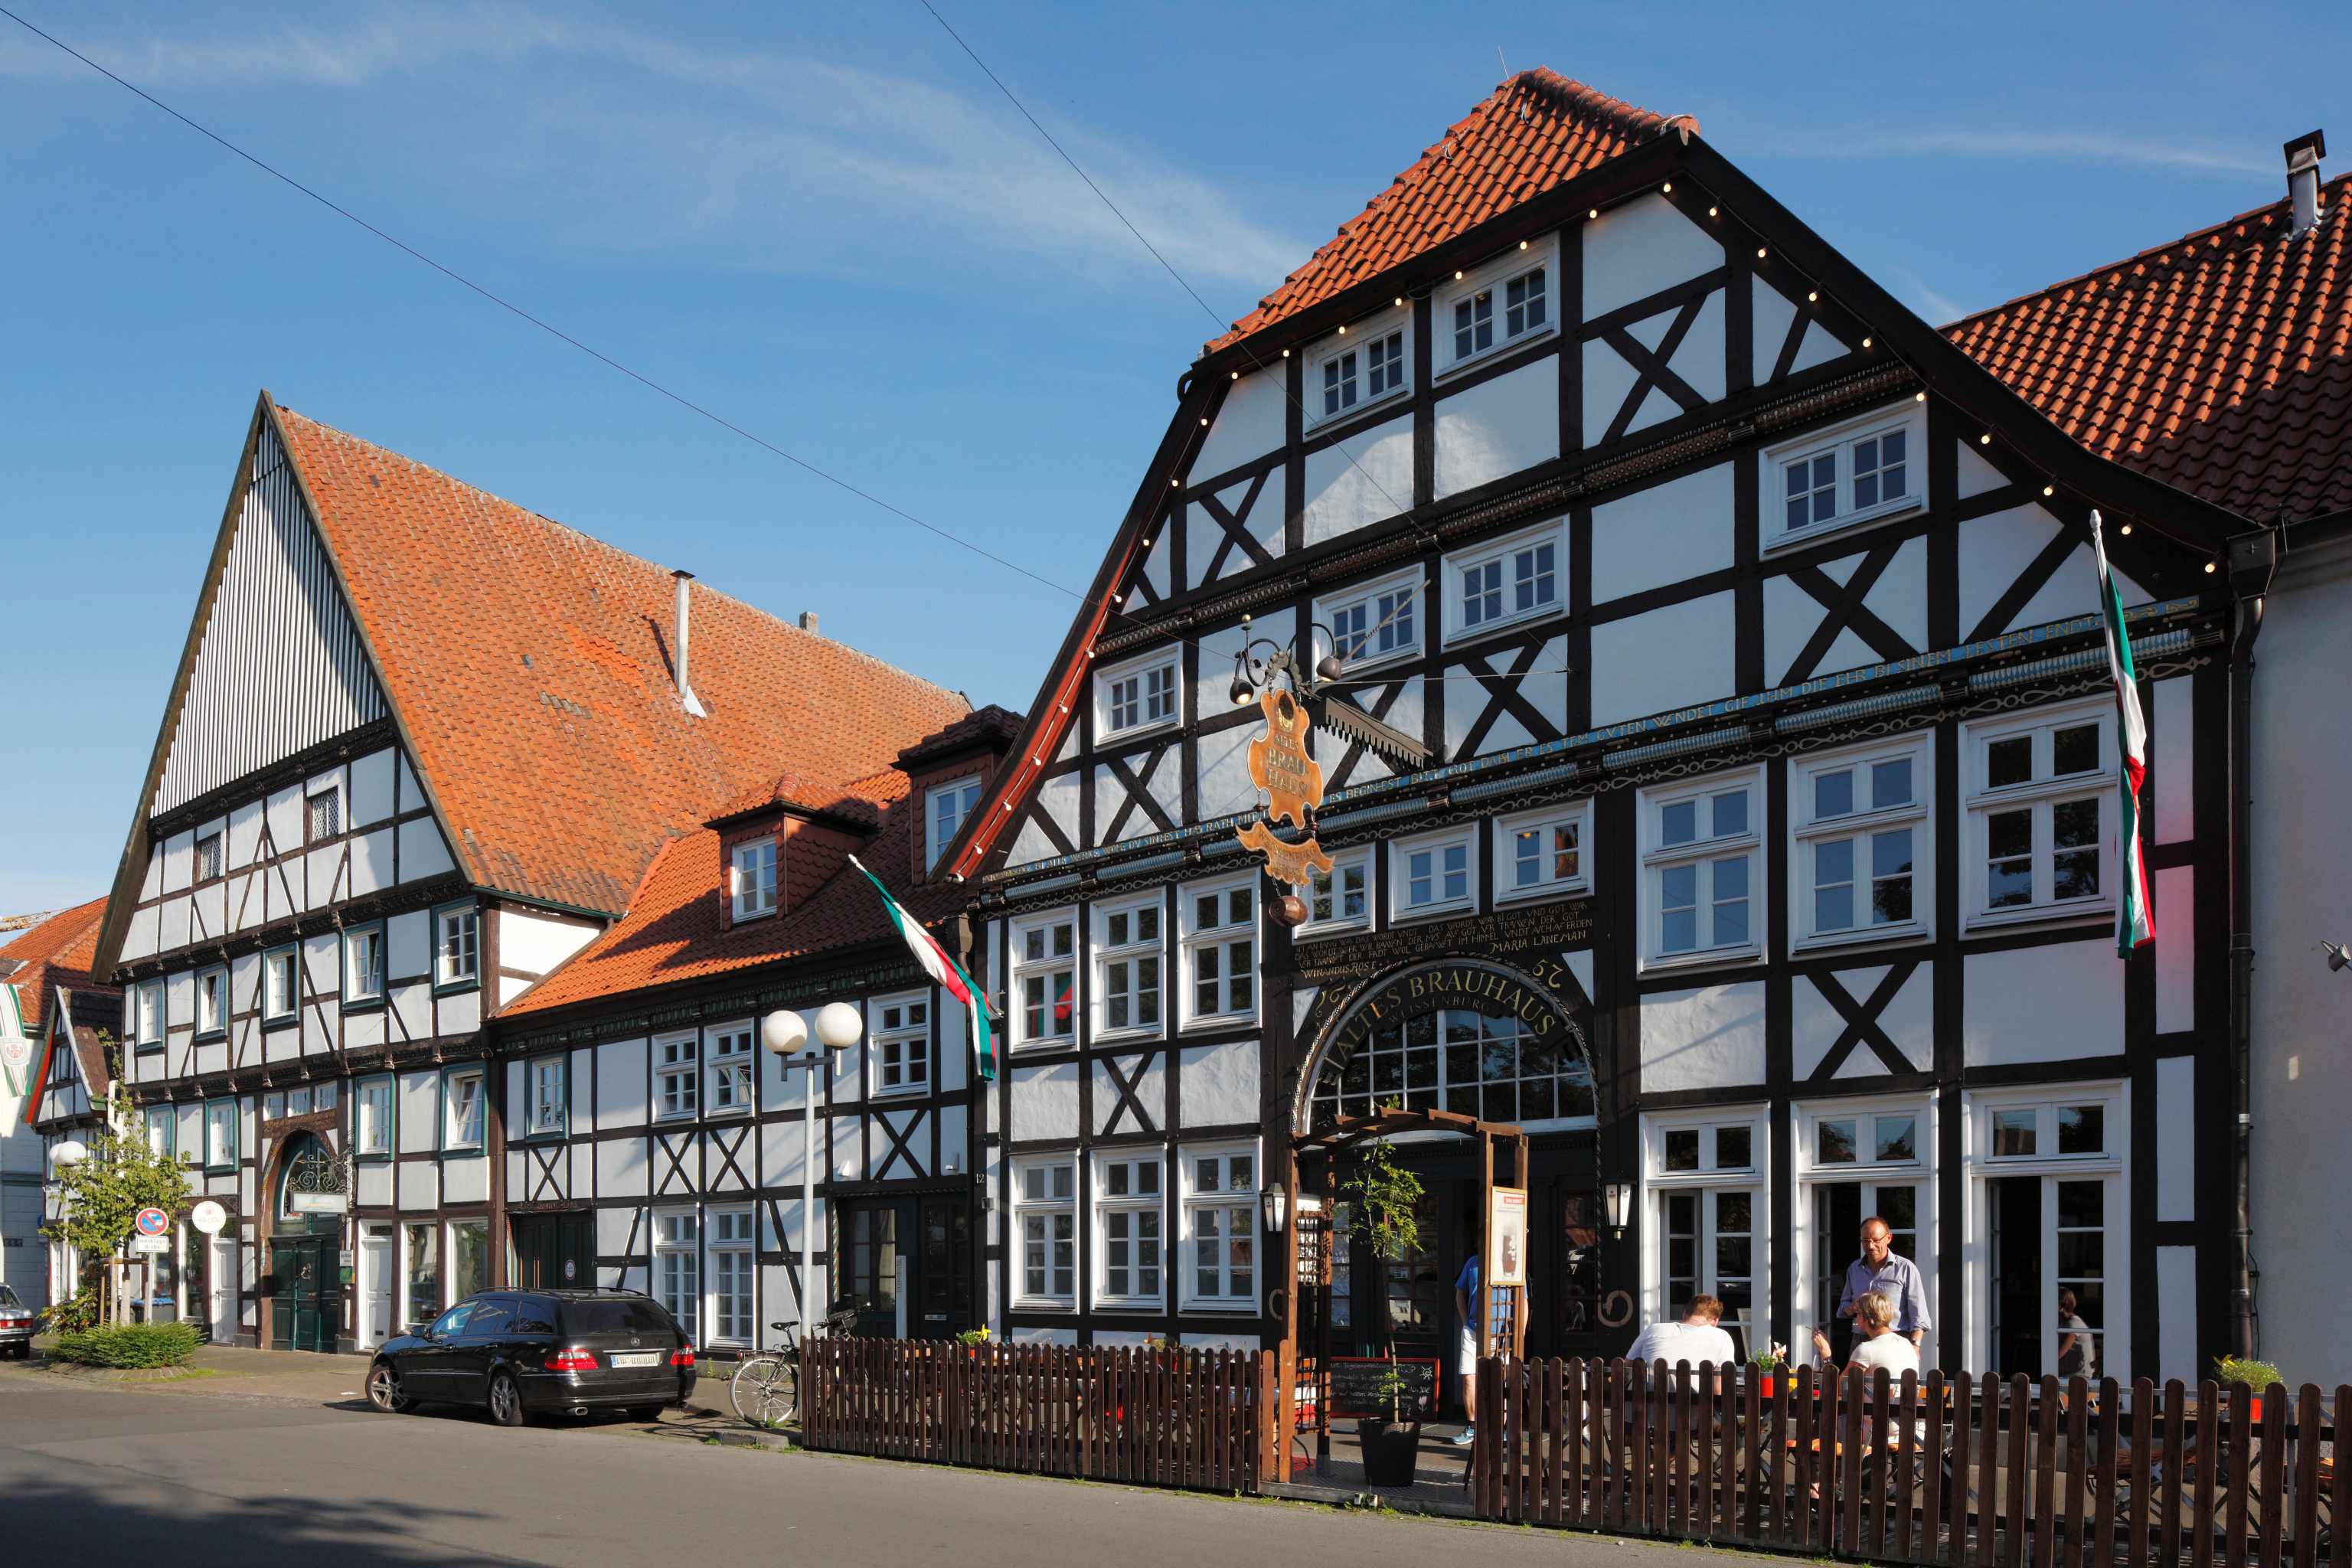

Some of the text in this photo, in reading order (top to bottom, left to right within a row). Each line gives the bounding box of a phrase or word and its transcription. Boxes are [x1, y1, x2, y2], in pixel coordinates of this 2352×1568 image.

[1207, 816, 1235, 831] RATH
[1329, 792, 1341, 804] ES
[1447, 760, 1475, 776] GOT
[1517, 746, 1533, 760] ER
[1540, 741, 1553, 756] ES
[1561, 733, 1589, 750] TEM
[1596, 720, 1647, 741] GVTEN
[1652, 704, 1715, 727] WENDET
[1724, 696, 1749, 713] GIF
[1802, 677, 1828, 695] DIE
[1836, 669, 1866, 688] EHR
[1897, 648, 1952, 674] SINEM
[1965, 629, 2034, 660] LESTEN
[2045, 616, 2095, 639] ENDT
[1274, 733, 1299, 752] ALTES
[1267, 768, 1307, 799] HAUS
[1259, 828, 1315, 862] WEISSENBURG
[1295, 952, 1309, 961] DAS
[1312, 948, 1337, 958] WORDT
[1408, 935, 1423, 946] DER
[1461, 926, 1477, 936] GOT
[1540, 915, 1556, 925] DER
[1563, 911, 1579, 921] GOT
[1349, 952, 1362, 962] DER
[1392, 946, 1411, 955] WOL
[1504, 926, 1530, 938] VNDT
[1566, 919, 1592, 929] ERDEN
[1356, 935, 1370, 944] DAS
[1373, 932, 1395, 941] WORDT
[1429, 923, 1444, 933] DAS
[1447, 919, 1474, 930] WORDT
[1506, 911, 1522, 920] GOT
[1526, 907, 1546, 917] VND
[1548, 904, 1566, 914] GOT
[1489, 937, 1528, 954] MARIA
[1337, 969, 1556, 1061] ALTES BRAUHAUS
[1389, 995, 1491, 1024] WEISSENBURG
[975, 1173, 985, 1184] 12
